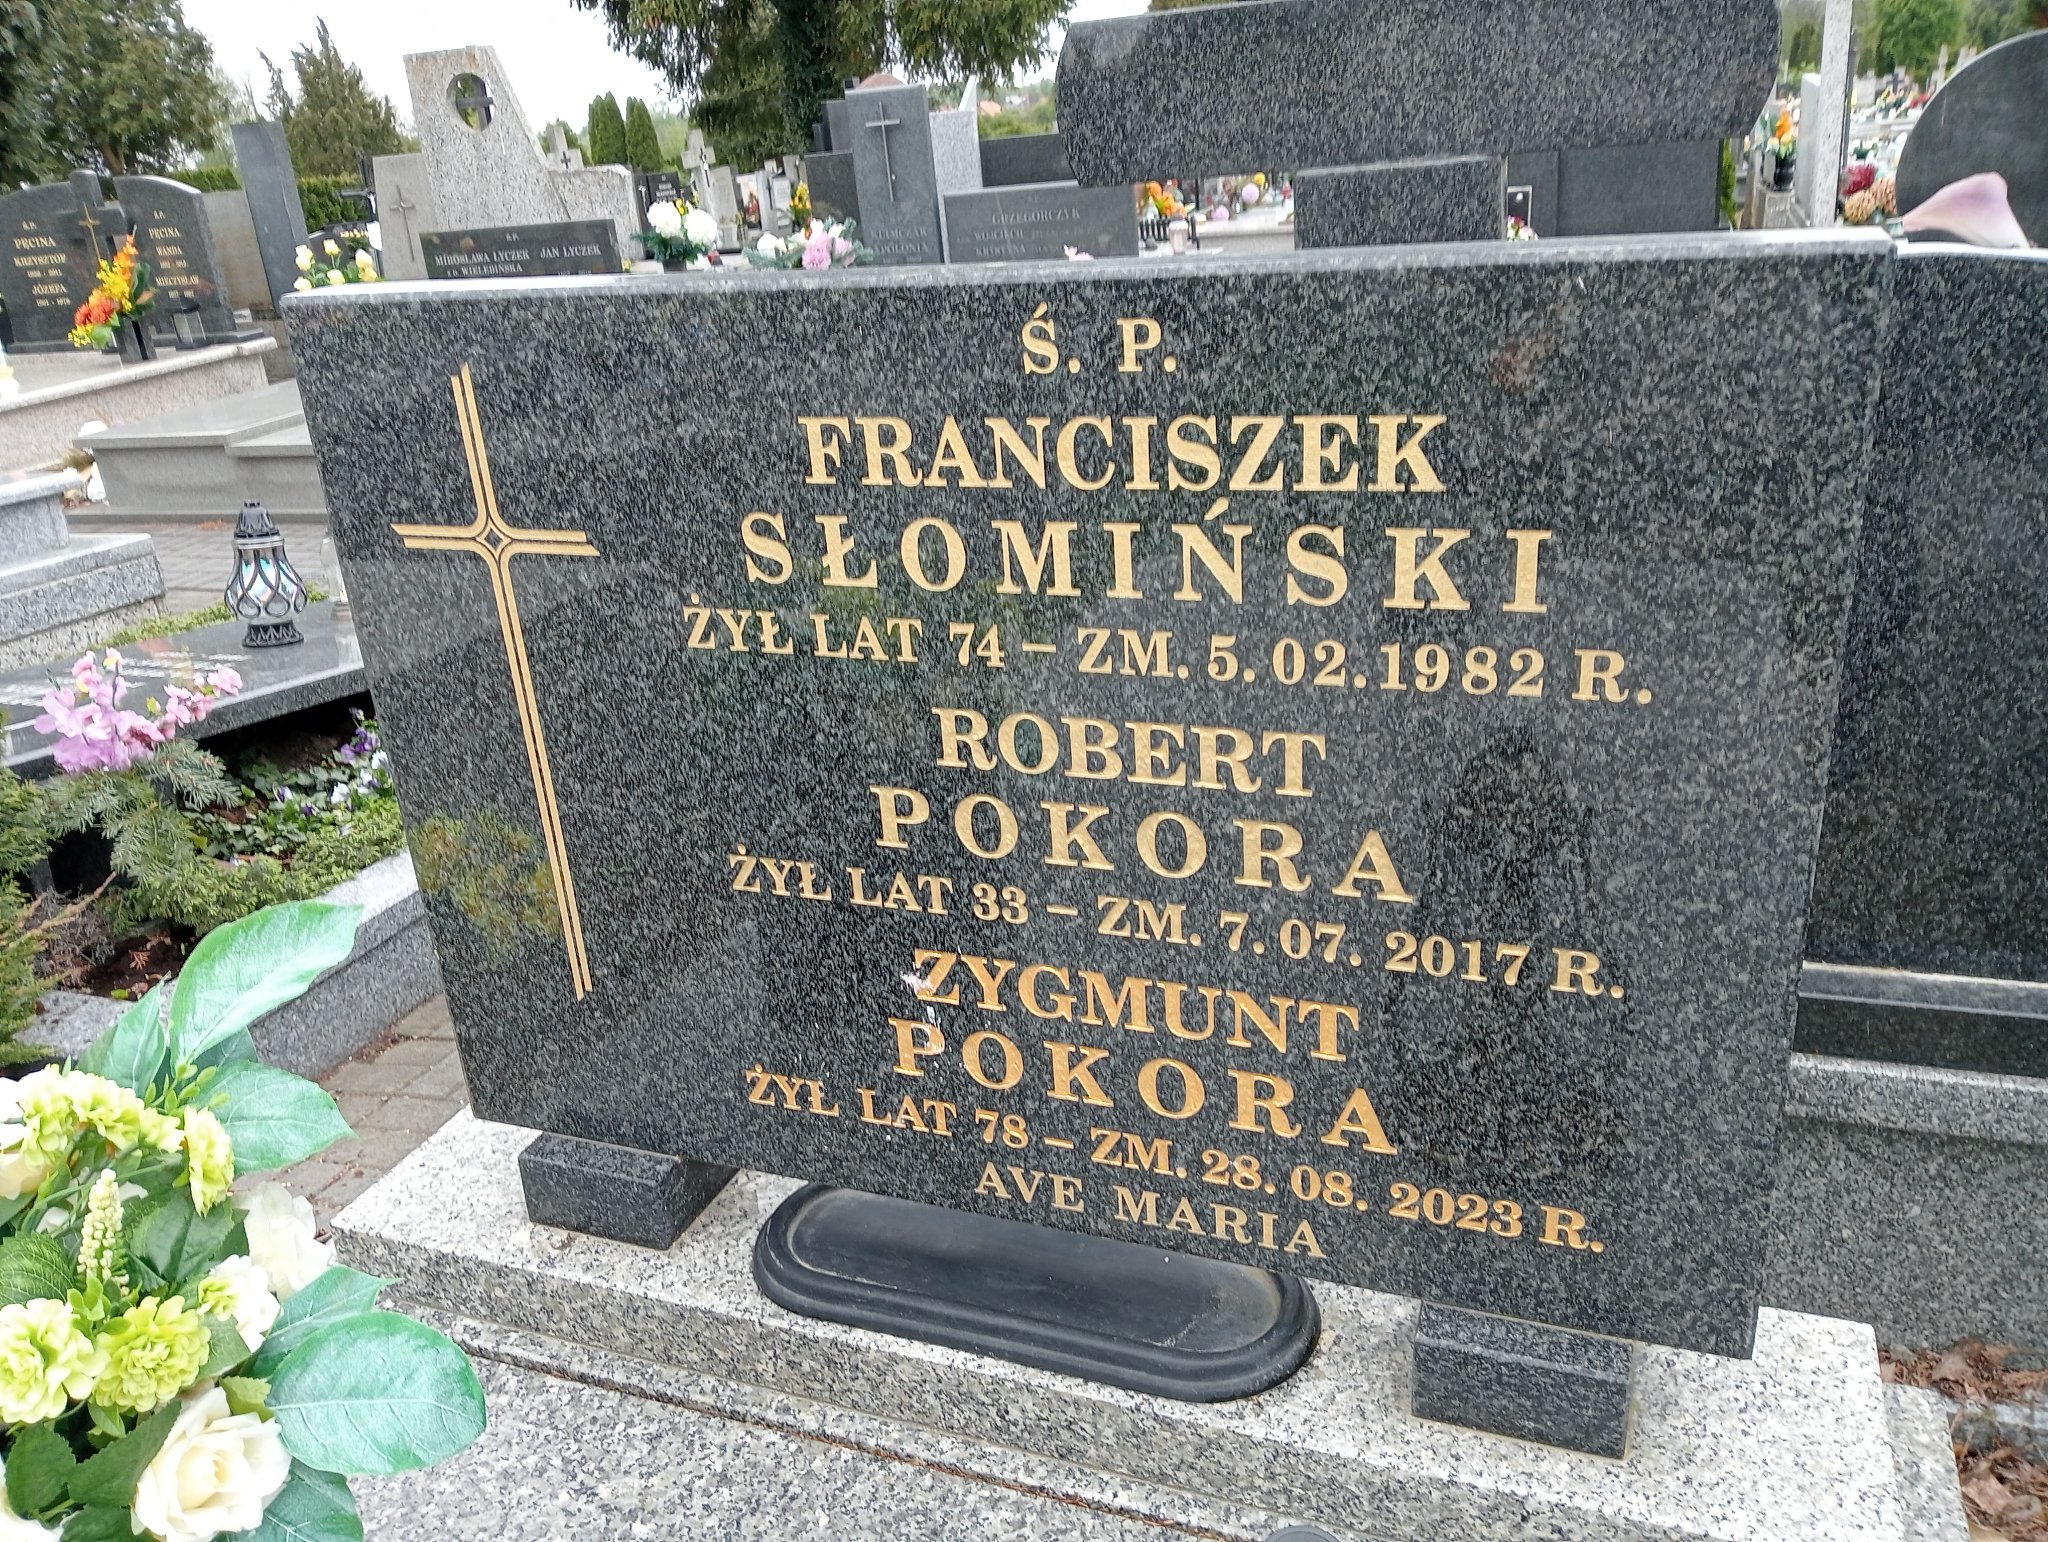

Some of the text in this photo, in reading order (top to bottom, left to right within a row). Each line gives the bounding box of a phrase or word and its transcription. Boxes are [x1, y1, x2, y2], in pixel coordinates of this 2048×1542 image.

[13, 253, 66, 268] KRZYSZTOF
[155, 245, 183, 257] WANDA
[540, 246, 560, 259] JAN
[992, 207, 1080, 225] GRZEGORCZYK
[798, 413, 1447, 493] FRANCISZEK
[740, 496, 1553, 614] SŁOMIŃSKI
[683, 592, 794, 655] ŻYŁ
[809, 607, 925, 664] LAT
[948, 620, 1006, 668] 74
[1077, 626, 1190, 679] ZM.
[1571, 648, 1653, 705] R.
[932, 706, 1327, 798] ROBERT
[869, 783, 1415, 904] POKORA
[728, 843, 833, 901] ŻYŁ
[847, 866, 954, 916] LAT
[972, 882, 1029, 925] 33
[1097, 895, 1202, 947] ZM.
[1551, 947, 1625, 999] R.
[913, 948, 1360, 1062] ZYGMUNT
[887, 1017, 1399, 1156] POKORA
[745, 1063, 841, 1118] ŻYŁ
[858, 1086, 958, 1137] LAT
[974, 1107, 1029, 1149] 78
[1090, 1126, 1188, 1180] ZM.
[1539, 1204, 1605, 1254] R.
[975, 1161, 1326, 1260] AVE MARIA
